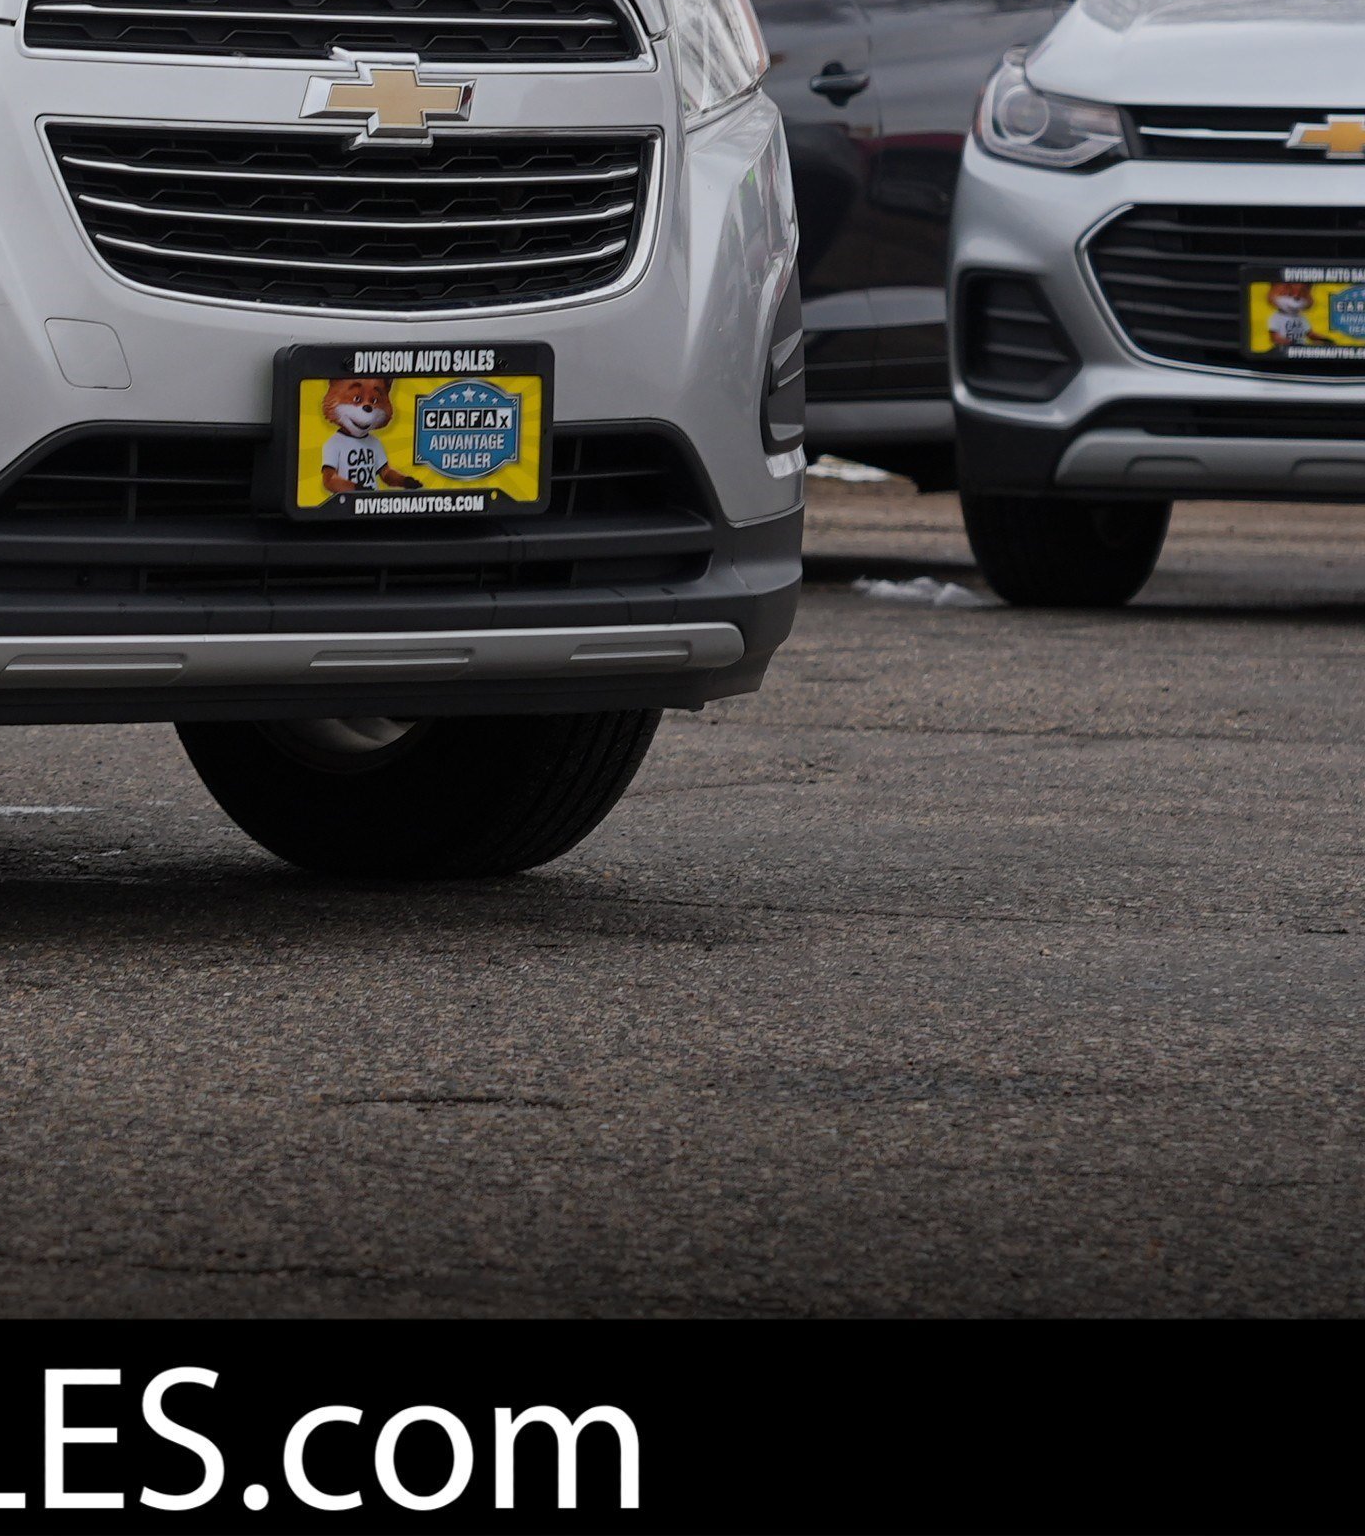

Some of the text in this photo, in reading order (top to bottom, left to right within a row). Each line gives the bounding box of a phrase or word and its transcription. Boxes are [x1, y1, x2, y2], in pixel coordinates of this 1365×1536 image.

[354, 349, 495, 374] DIVISION AUTO SALES
[425, 409, 511, 429] CARFAX
[429, 434, 505, 451] ADVANTAGE
[347, 448, 375, 466] CAR
[441, 452, 492, 470] DEALER
[347, 465, 376, 484] FOX
[354, 495, 485, 515] DIVISIONAUTOS.COM
